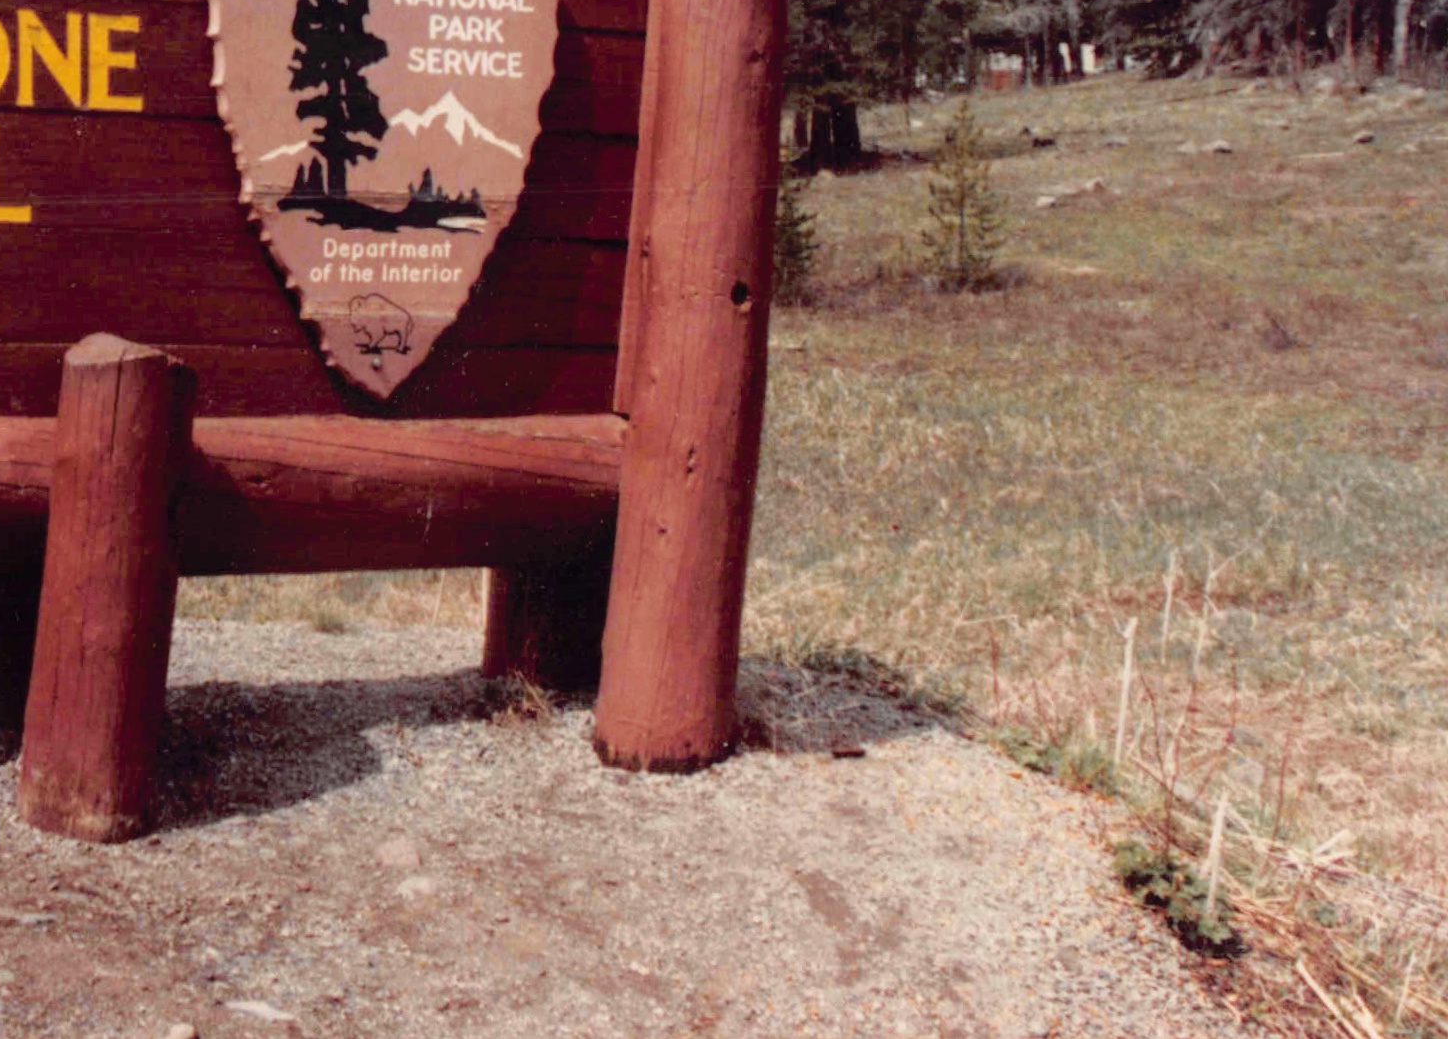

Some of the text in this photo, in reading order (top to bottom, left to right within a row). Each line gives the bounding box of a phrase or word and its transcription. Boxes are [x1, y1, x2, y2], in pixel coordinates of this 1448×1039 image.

[428, 15, 504, 44] PARK
[407, 49, 524, 78] SERVICE
[323, 238, 452, 262] Department
[309, 263, 463, 283] of the Interior
